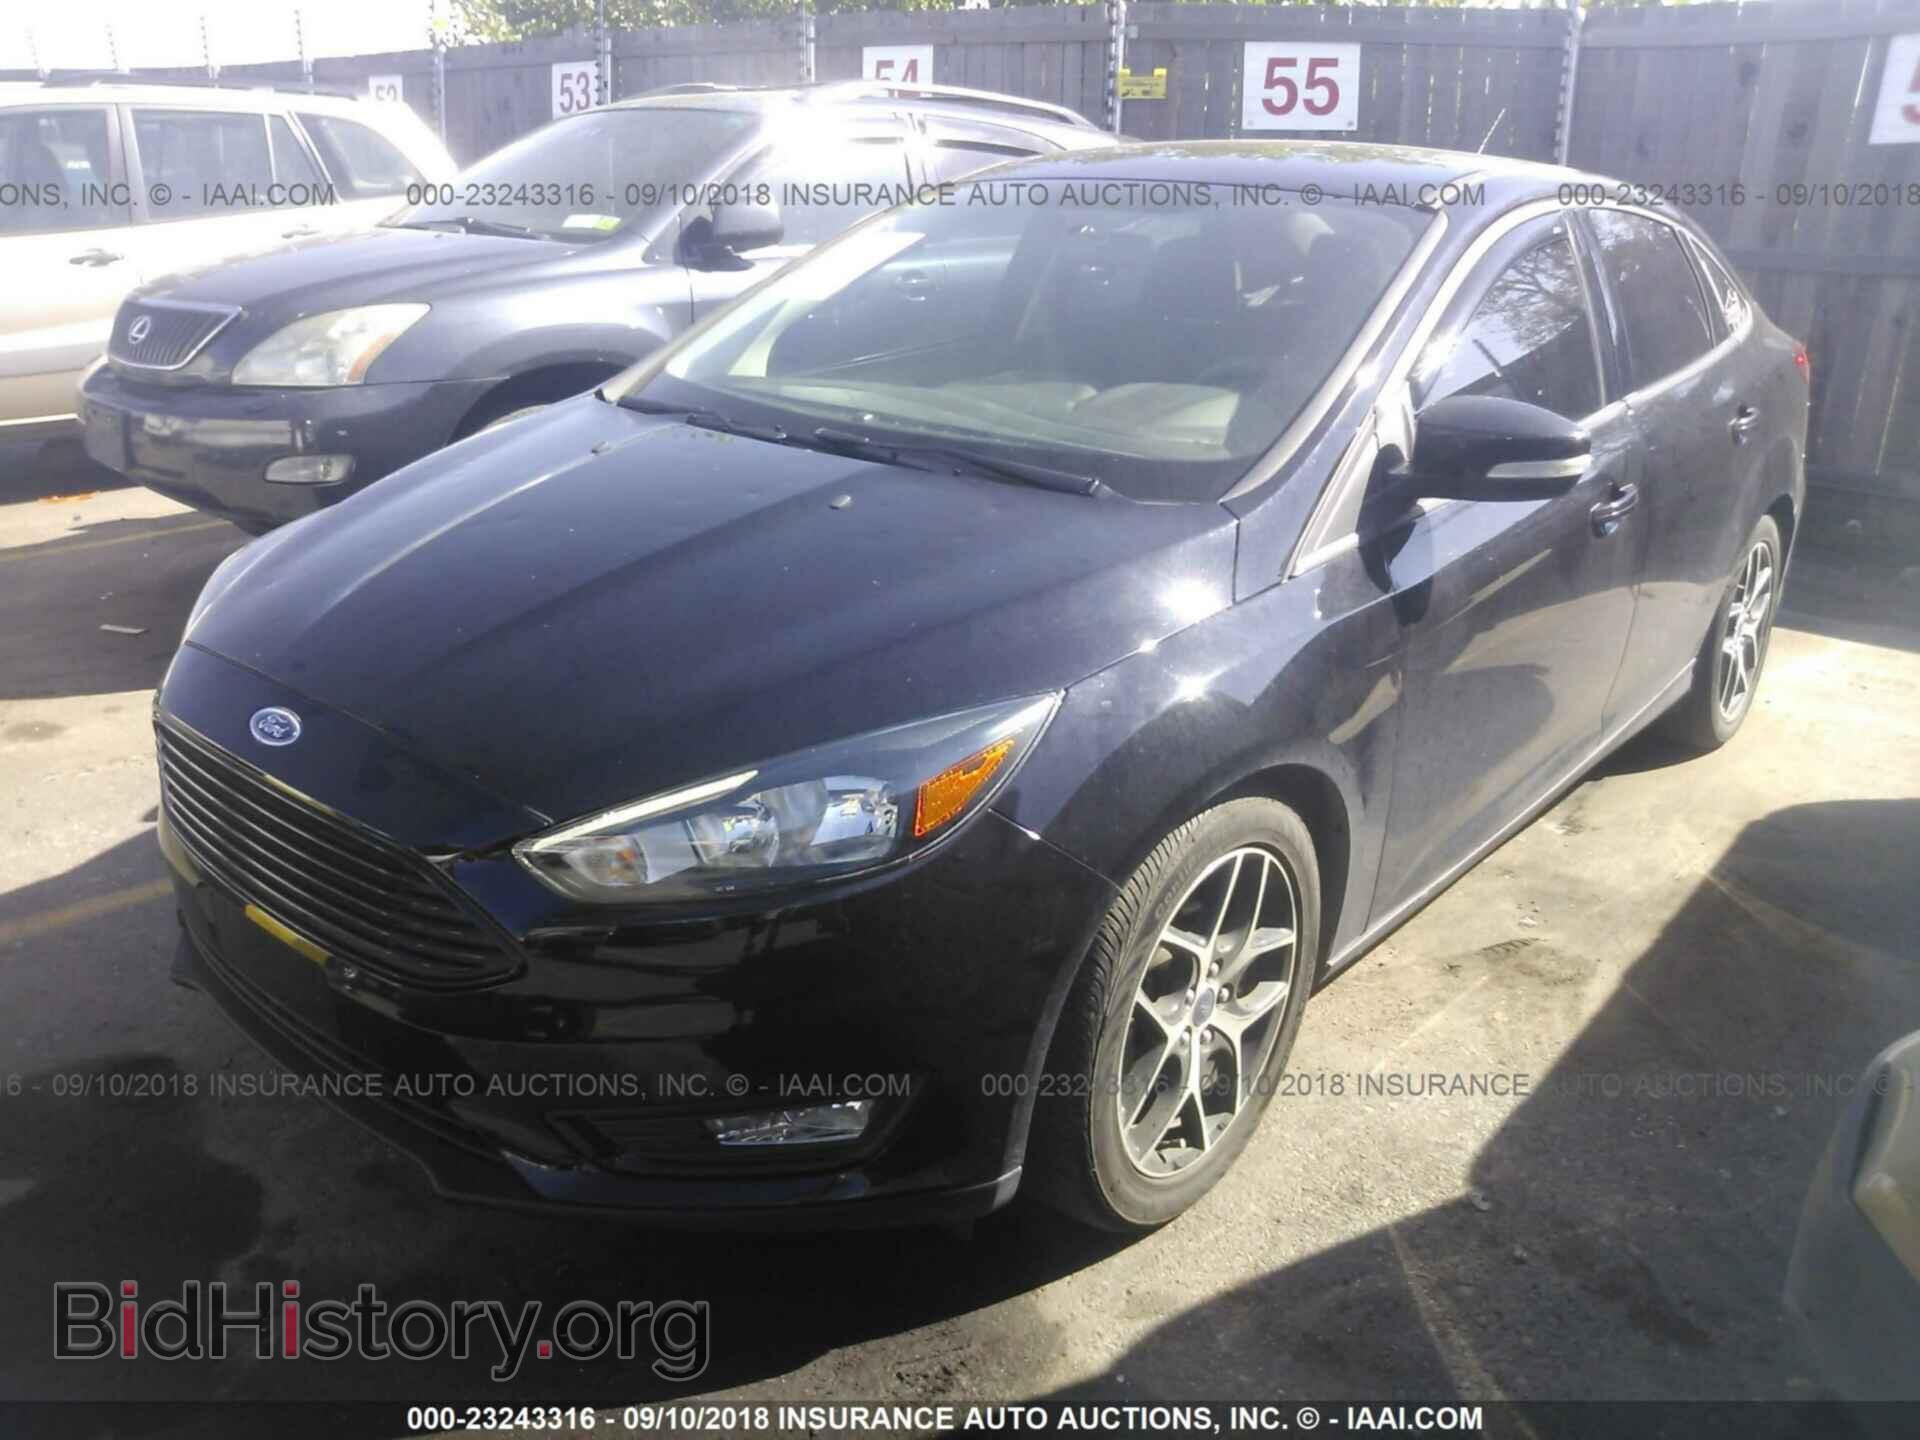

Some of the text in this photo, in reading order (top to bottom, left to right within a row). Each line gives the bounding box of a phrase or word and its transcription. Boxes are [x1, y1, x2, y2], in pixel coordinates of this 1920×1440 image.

[559, 72, 591, 113] 53
[1261, 57, 1340, 116] 55
[258, 714, 290, 738] Ford
